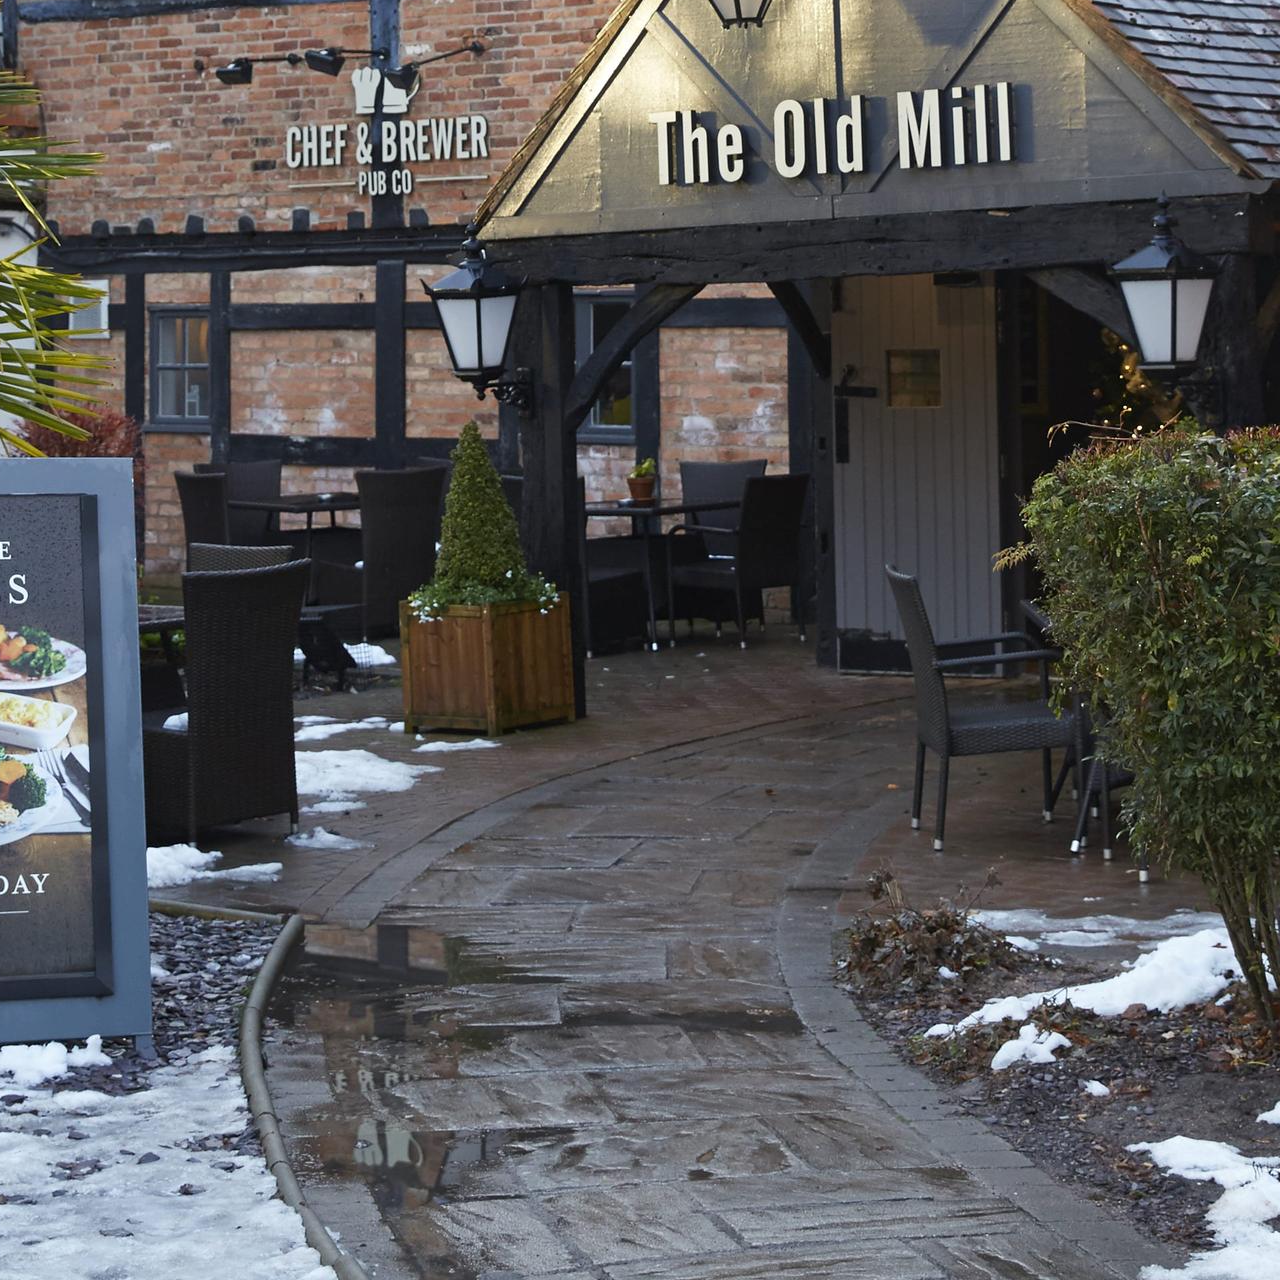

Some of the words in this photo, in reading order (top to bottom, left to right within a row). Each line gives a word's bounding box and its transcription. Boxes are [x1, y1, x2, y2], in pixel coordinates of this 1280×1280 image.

[286, 123, 349, 168] CHEF
[356, 122, 373, 165] &
[381, 115, 488, 163] BREWER
[648, 109, 745, 186] The
[773, 94, 865, 179] Old
[896, 81, 1012, 169] Mill
[358, 171, 387, 196] PUB
[391, 168, 413, 195] CO
